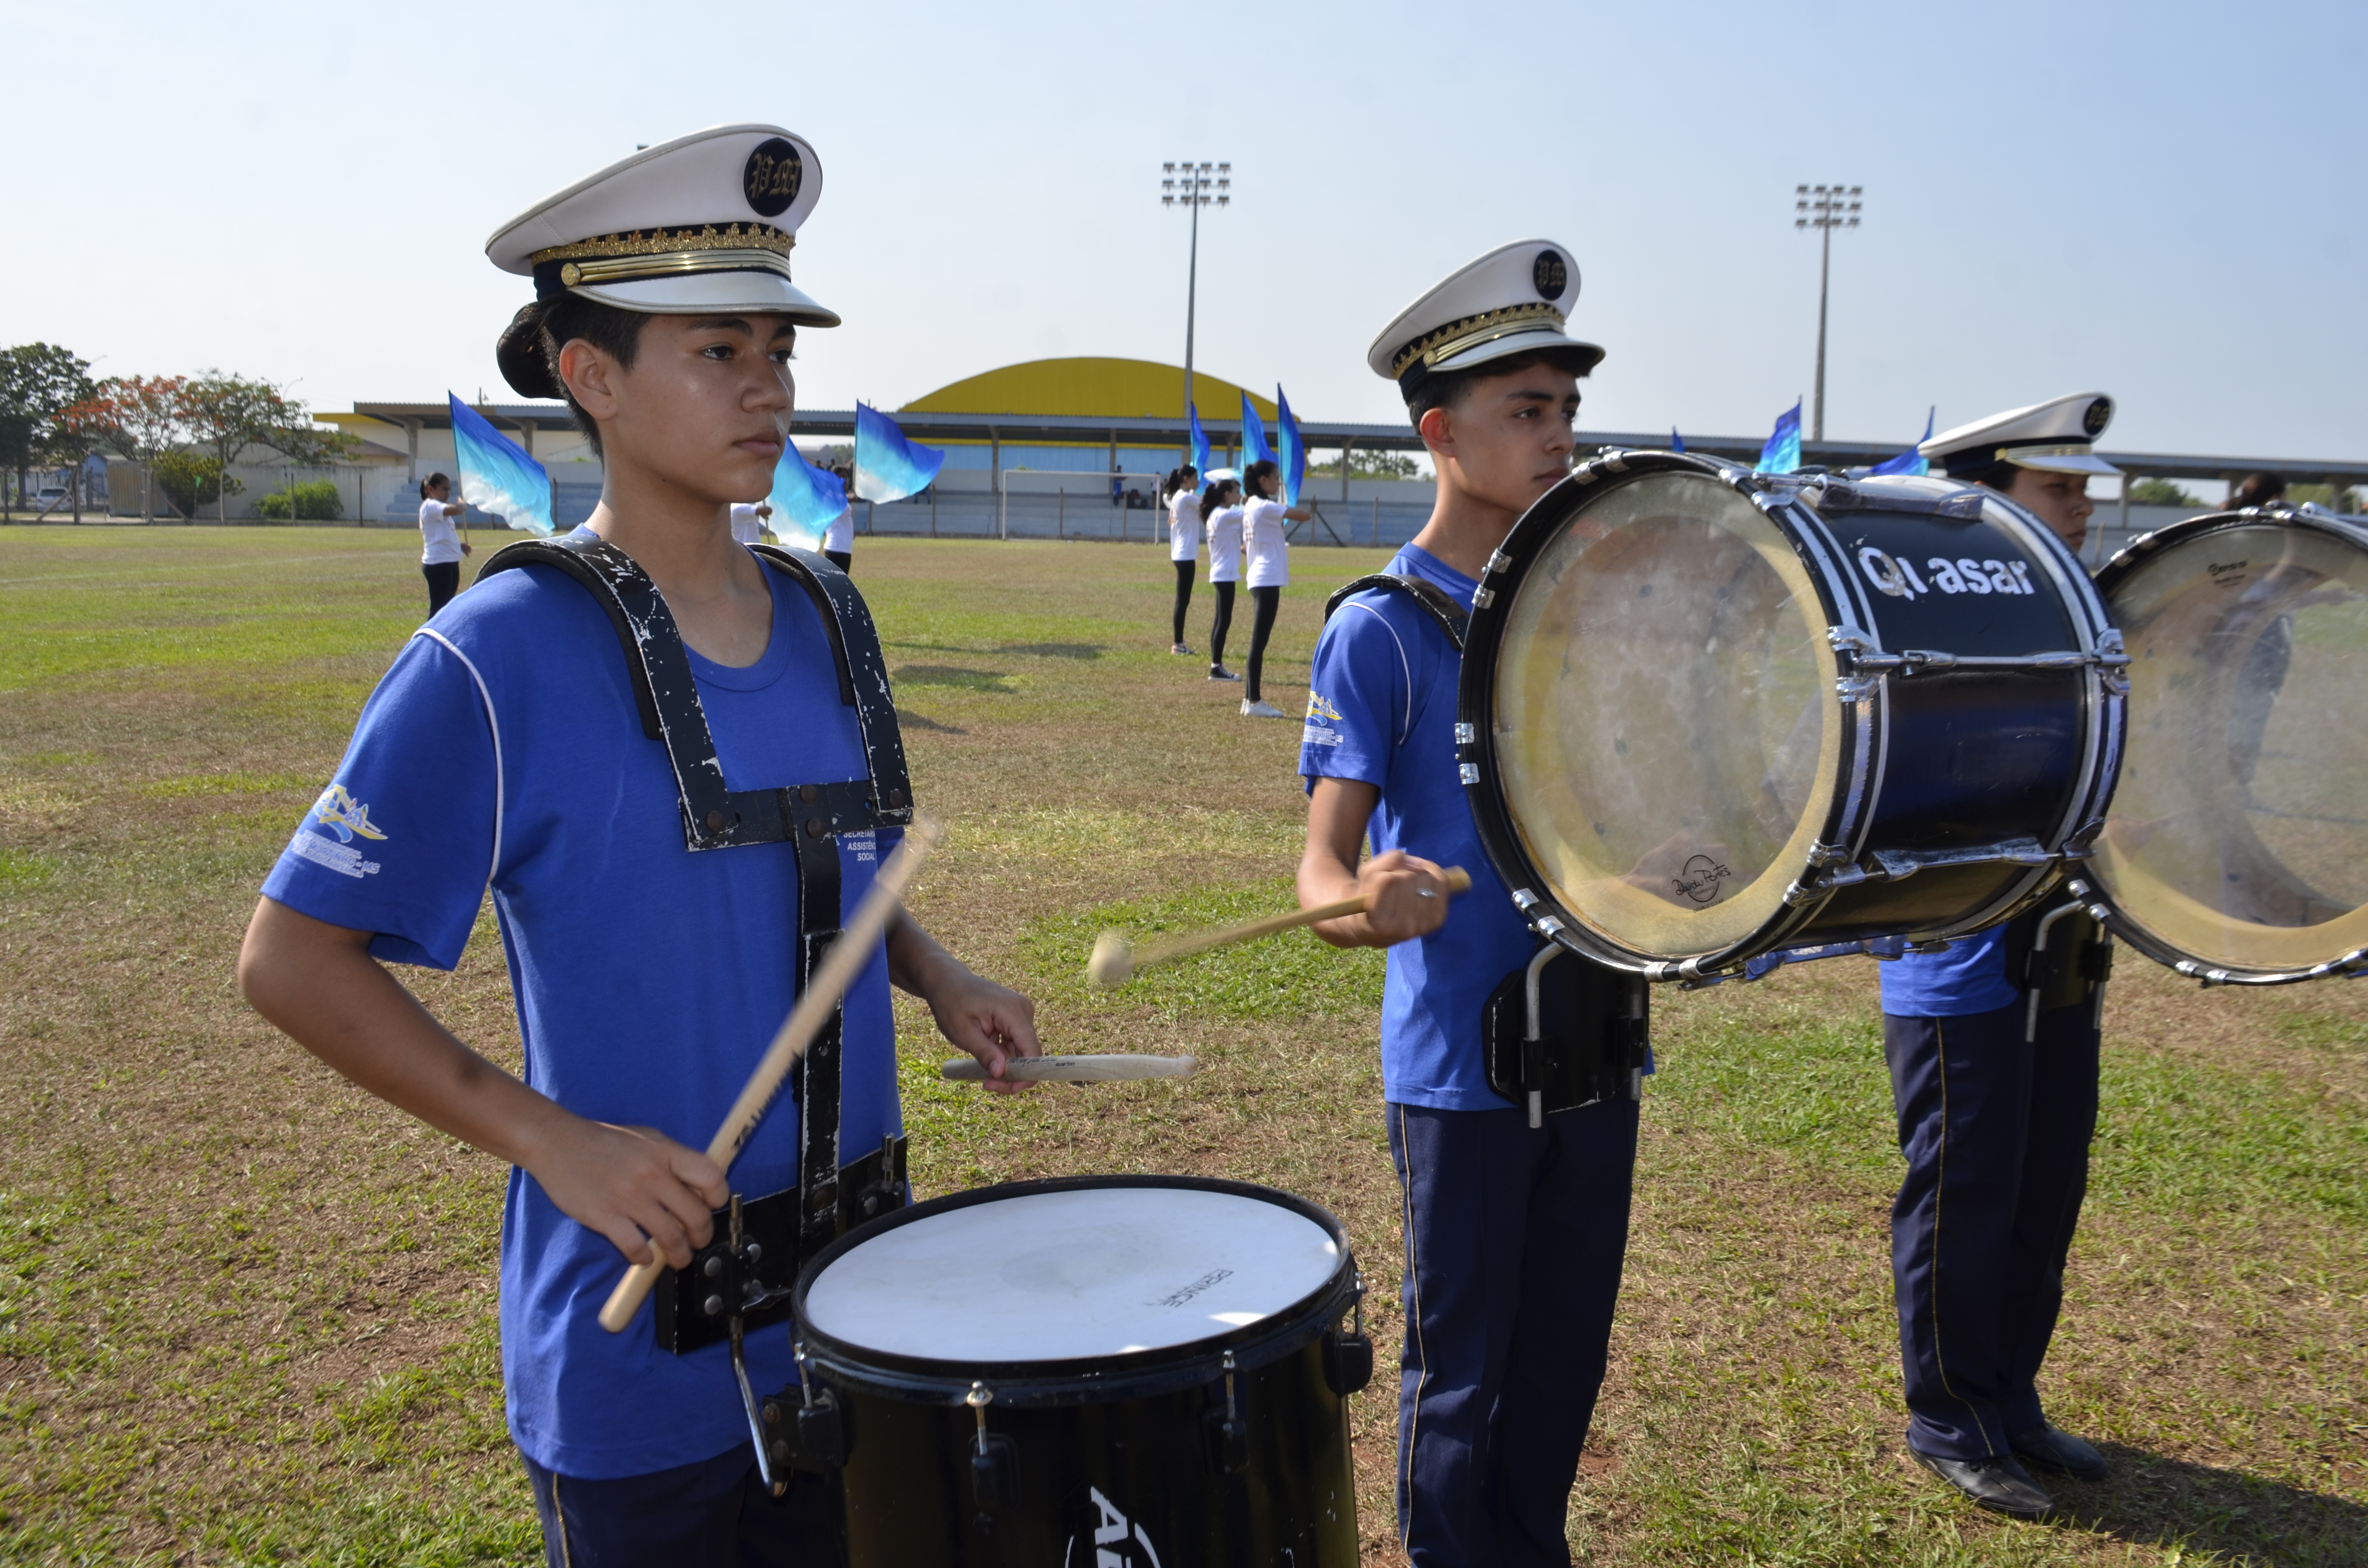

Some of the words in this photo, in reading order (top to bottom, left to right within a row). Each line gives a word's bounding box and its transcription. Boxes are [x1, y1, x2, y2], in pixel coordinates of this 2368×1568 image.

[857, 852, 875, 861] SOCIAL
[362, 860, 381, 874] MS
[1160, 1269, 1234, 1308] PRINCE
